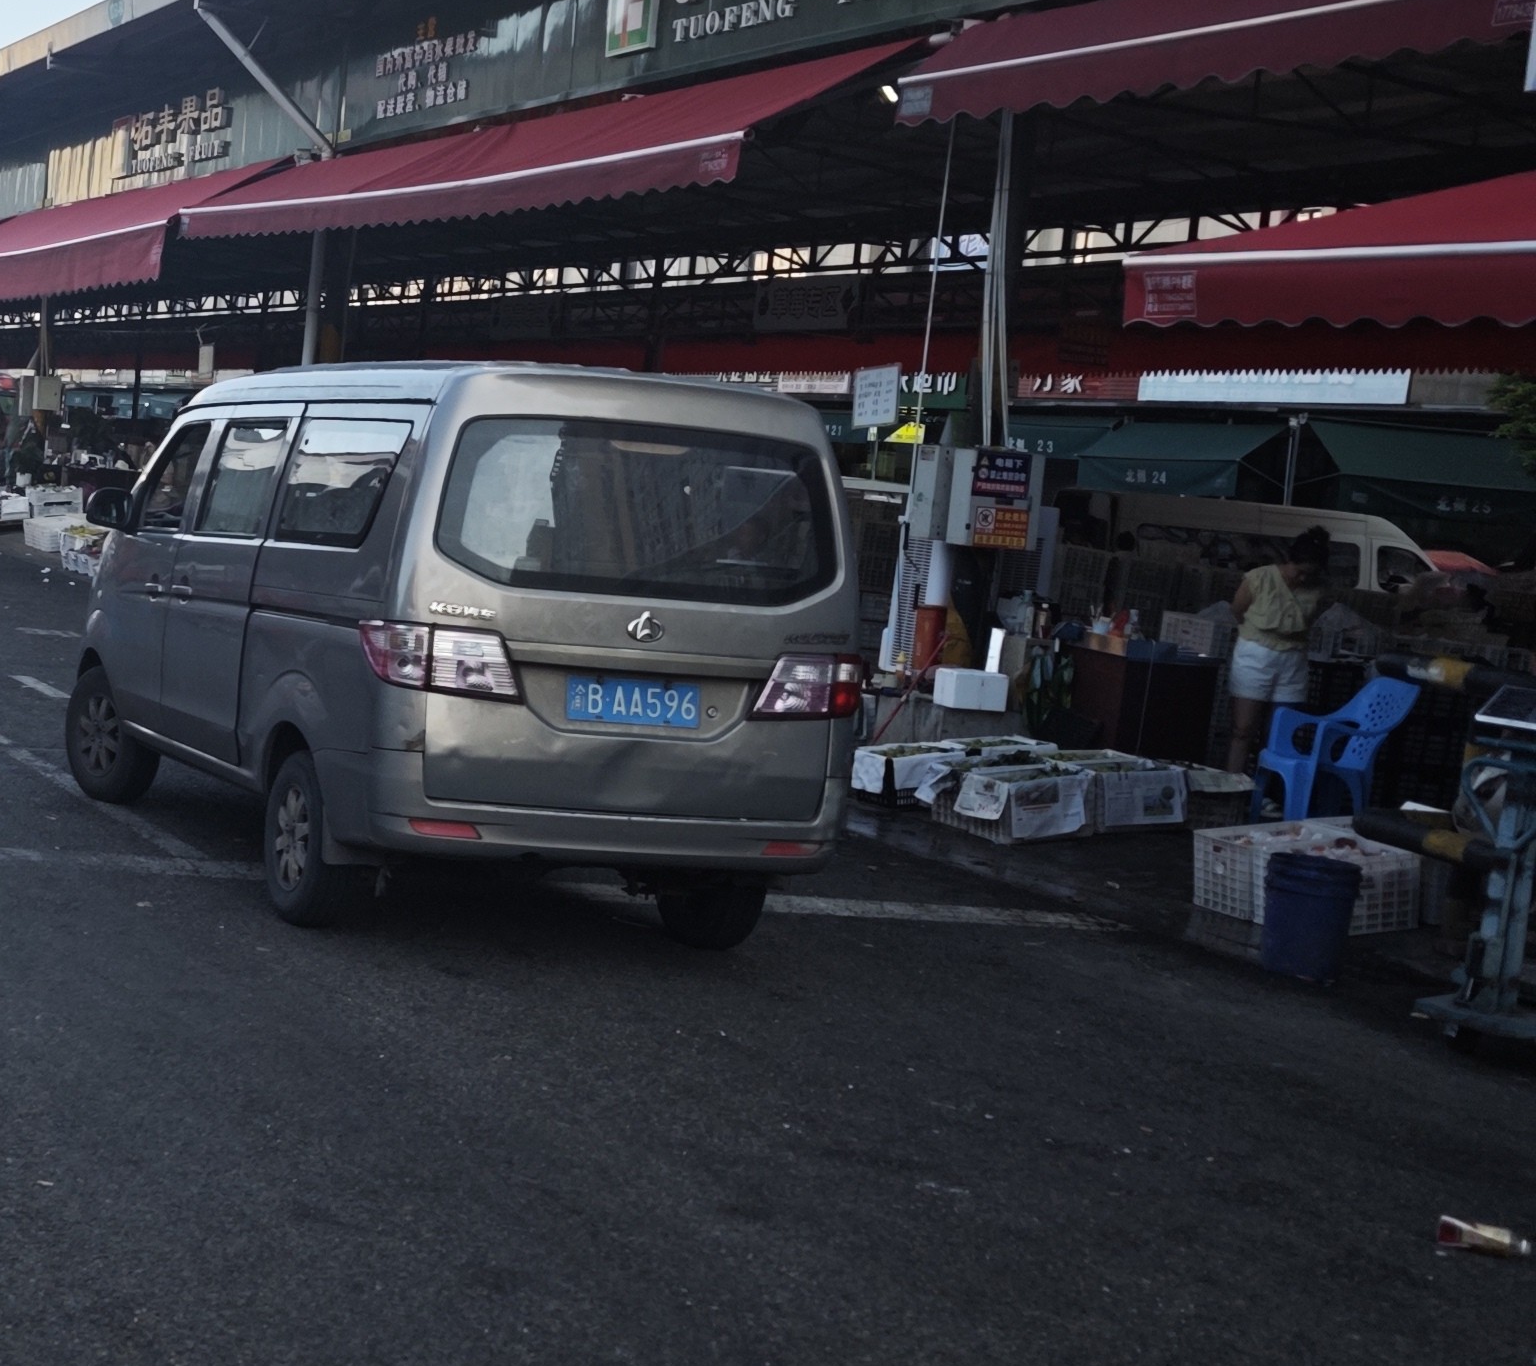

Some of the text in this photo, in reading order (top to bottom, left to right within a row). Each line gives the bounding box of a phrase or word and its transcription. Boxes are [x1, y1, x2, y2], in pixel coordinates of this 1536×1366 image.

[130, 86, 226, 151] 拓丰果品
[1037, 439, 1054, 453] 23
[1152, 471, 1167, 485] 24
